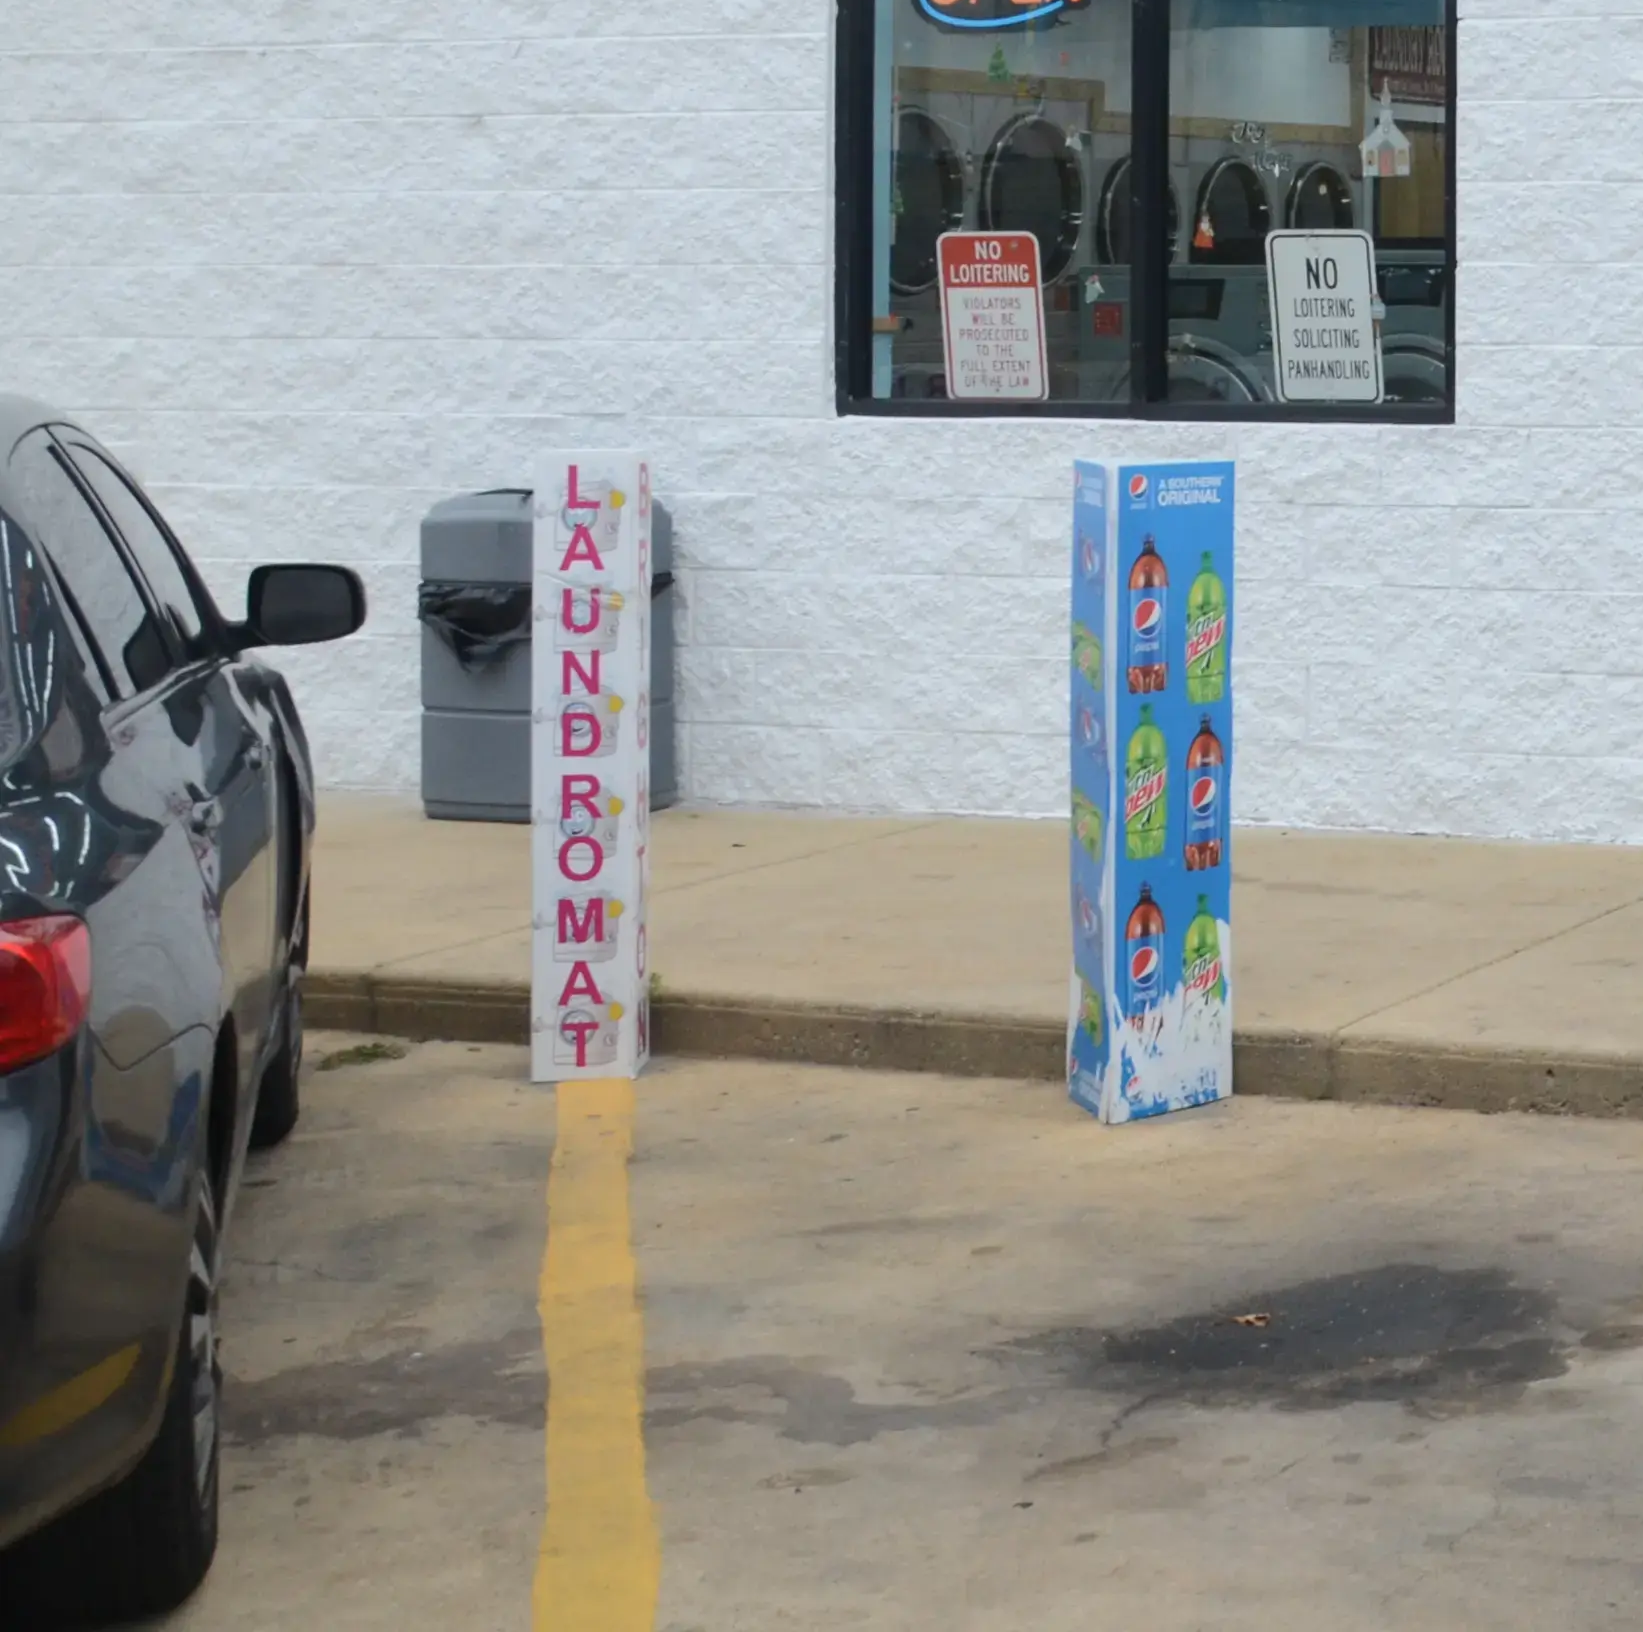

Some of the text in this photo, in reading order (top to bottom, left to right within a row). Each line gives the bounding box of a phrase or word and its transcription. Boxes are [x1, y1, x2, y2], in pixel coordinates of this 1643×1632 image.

[974, 240, 1002, 260] NO
[950, 263, 1030, 283] LOITERING
[1305, 257, 1338, 290] NO
[963, 297, 1022, 310] VIOLATORS
[1293, 298, 1355, 318] LOITERING
[972, 313, 1015, 325] WILL BE
[959, 329, 1029, 342] PROSECUTED
[1293, 328, 1360, 349] SOLICITING
[976, 345, 1014, 357] TO THE
[960, 360, 1031, 373] FULL EXTENT
[1288, 359, 1370, 380] PANHANDLING
[1008, 375, 1030, 387] LAW
[1157, 489, 1222, 507] ORIGINAL
[557, 464, 605, 1068] LAUNDROMAT
